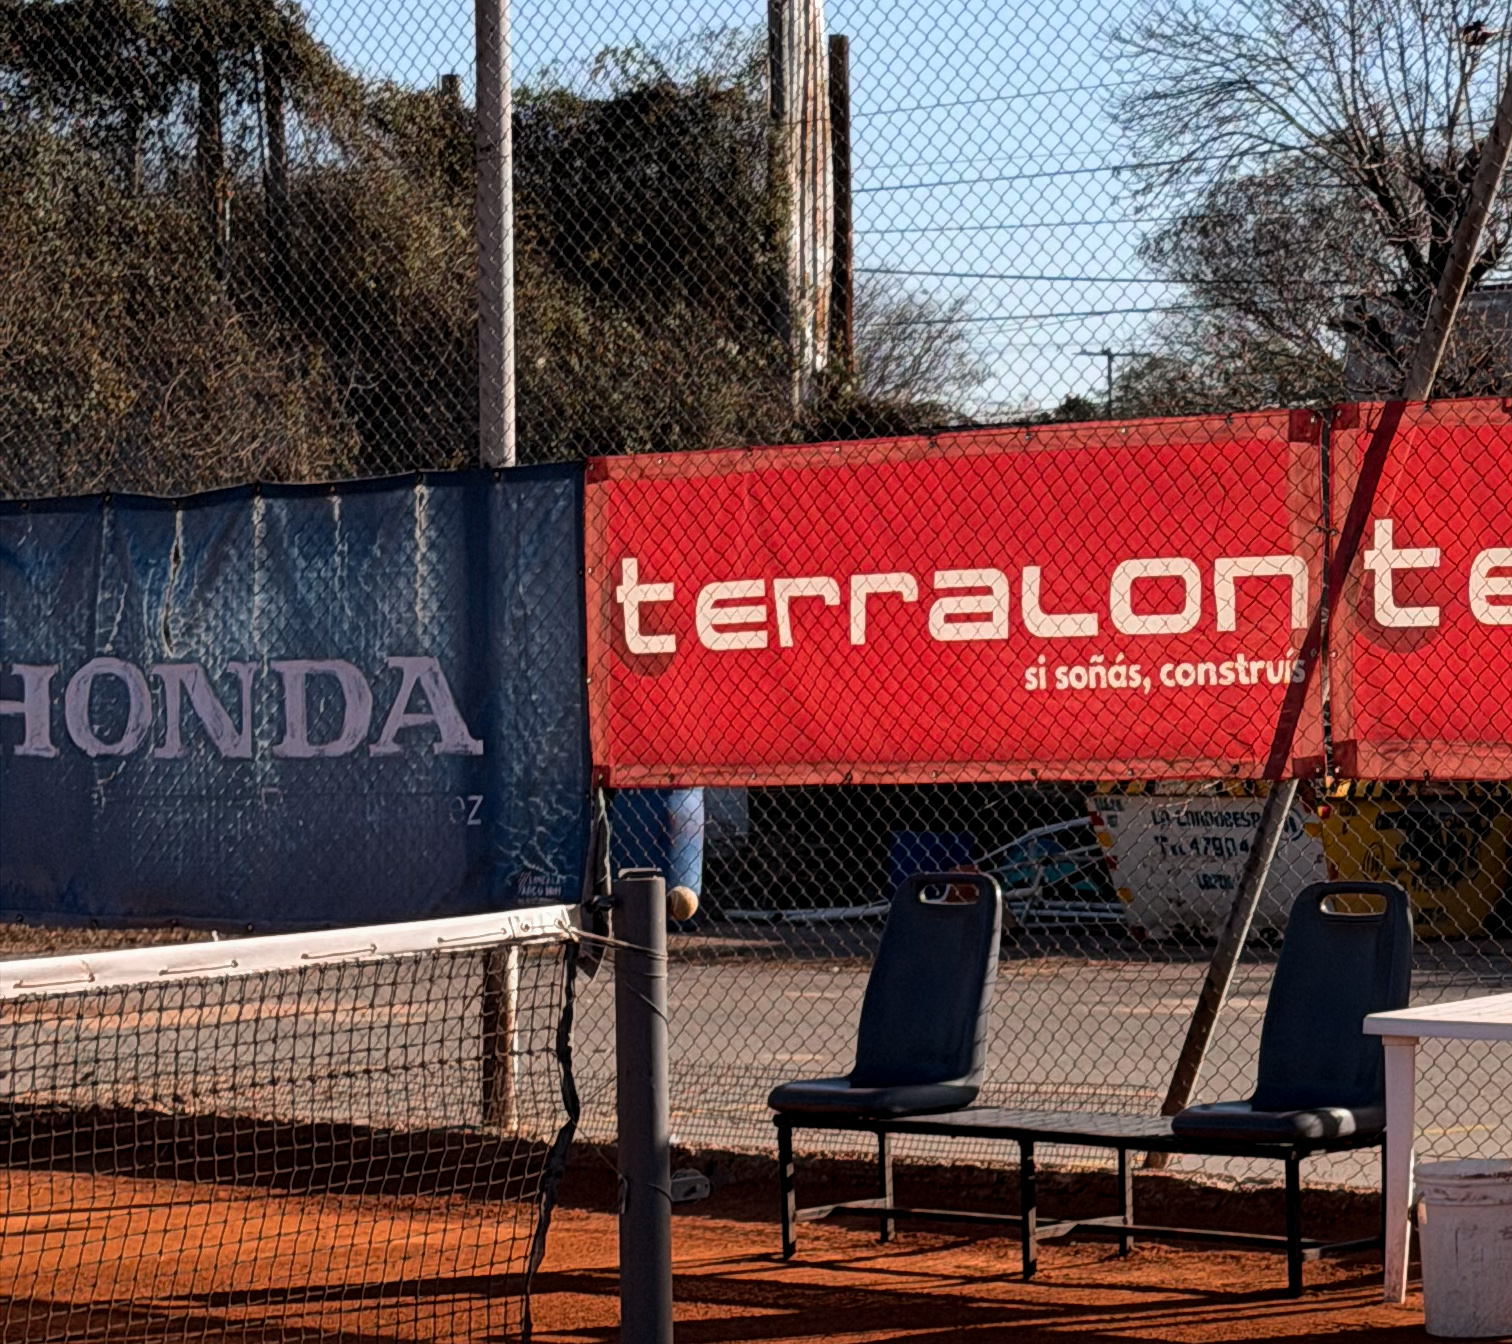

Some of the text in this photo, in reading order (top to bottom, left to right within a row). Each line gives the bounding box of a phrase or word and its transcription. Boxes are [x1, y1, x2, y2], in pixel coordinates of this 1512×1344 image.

[1024, 647, 1307, 696] si soñás, construís
